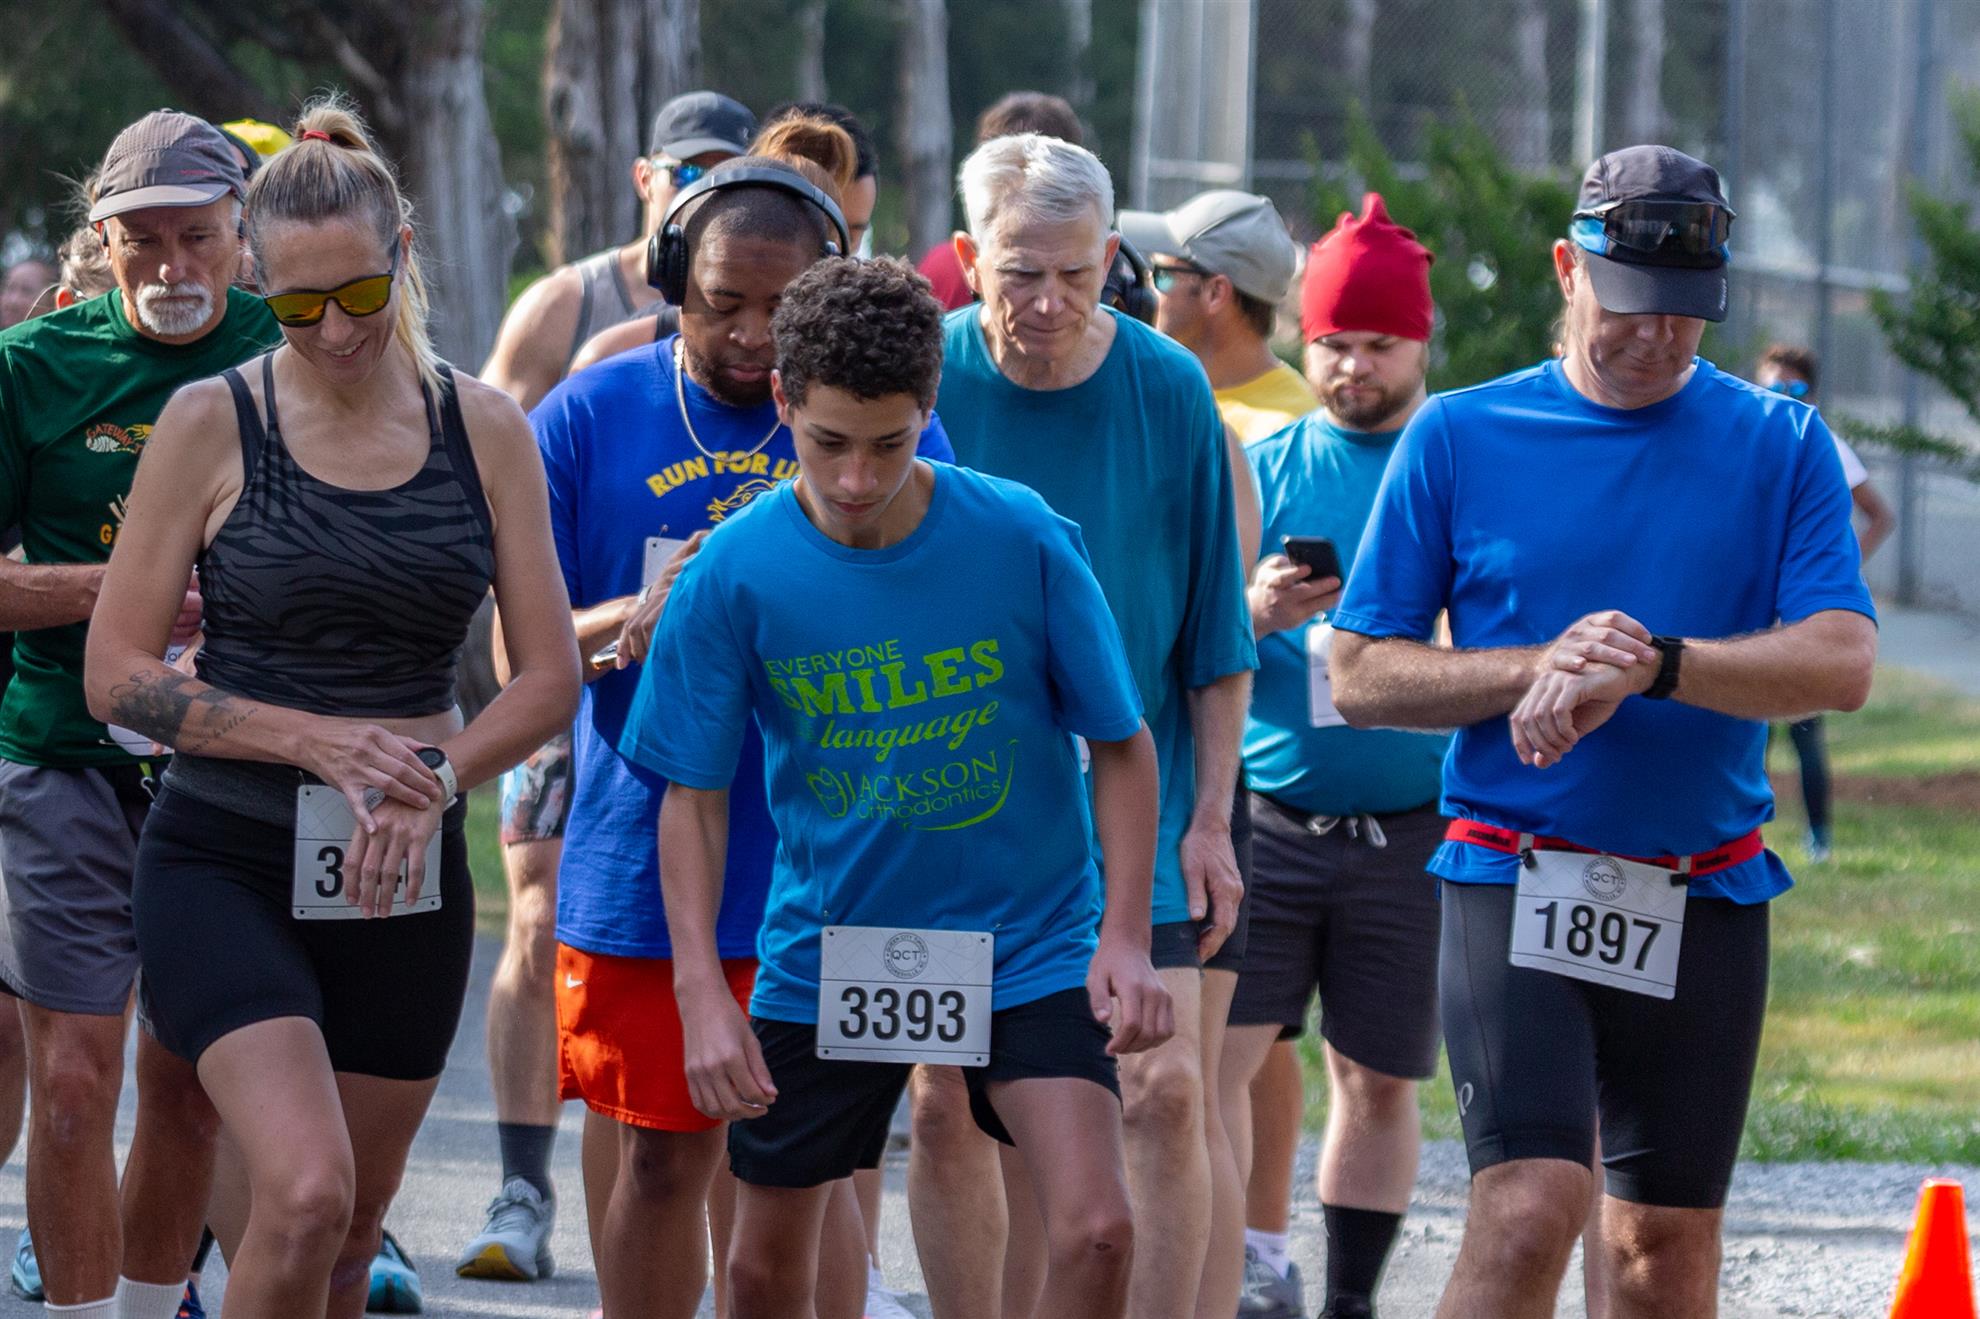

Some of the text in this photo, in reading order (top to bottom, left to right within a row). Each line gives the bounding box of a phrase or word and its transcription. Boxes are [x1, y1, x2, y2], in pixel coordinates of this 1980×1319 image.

[646, 456, 709, 498] RUN
[714, 451, 770, 475] FOR
[764, 639, 902, 675] EVERYONE
[769, 639, 1004, 717] SMILES
[820, 701, 999, 763] language
[843, 751, 998, 804] JACKSON
[856, 780, 1001, 820] Orthodontics
[891, 949, 921, 961] QCT
[1535, 901, 1662, 972] 1897
[839, 985, 967, 1044] 3393
